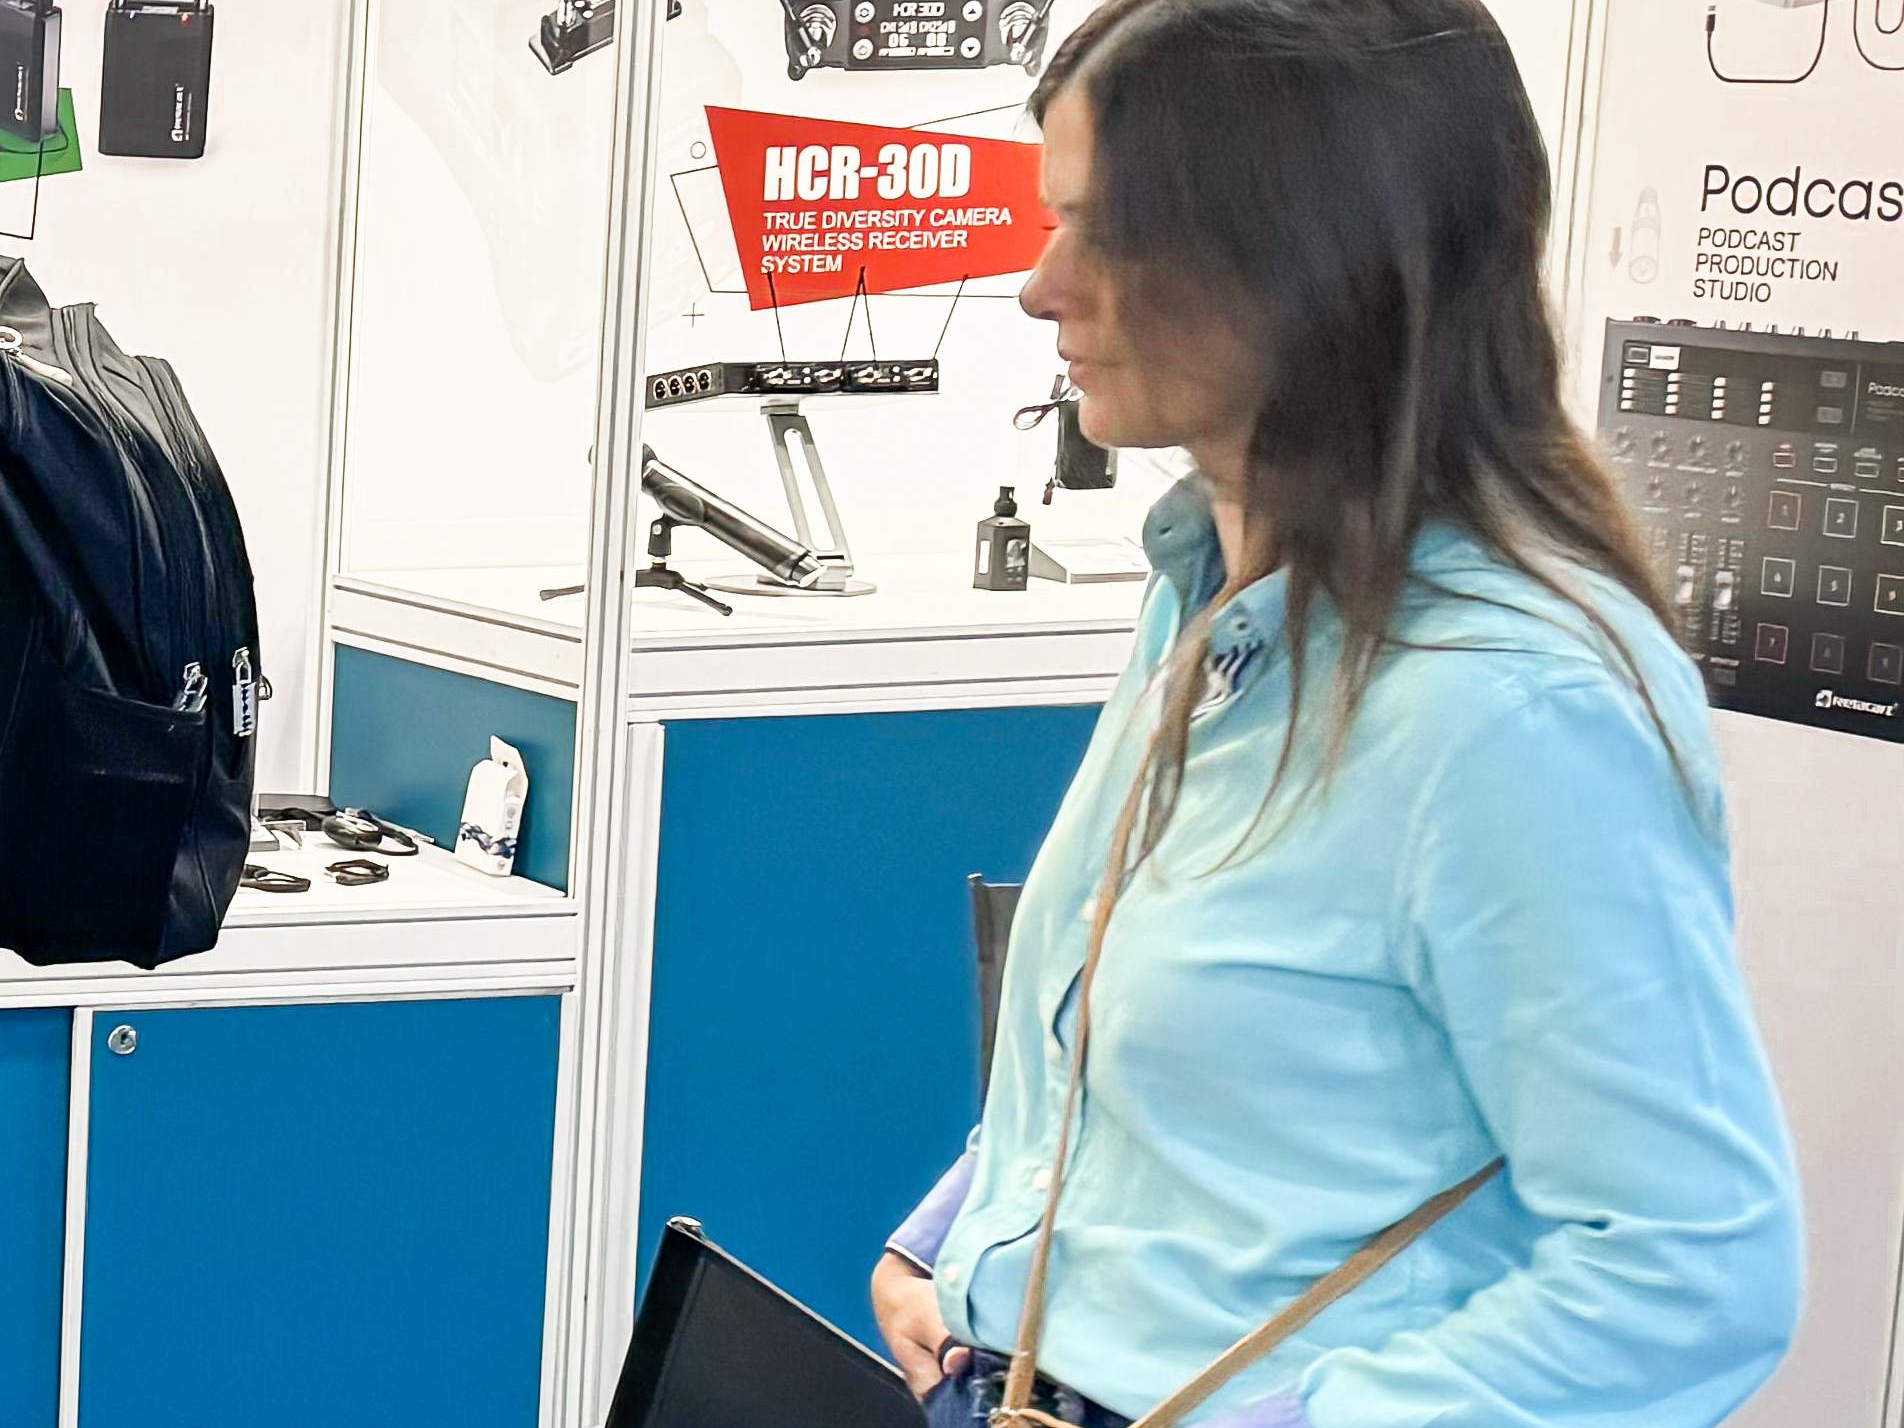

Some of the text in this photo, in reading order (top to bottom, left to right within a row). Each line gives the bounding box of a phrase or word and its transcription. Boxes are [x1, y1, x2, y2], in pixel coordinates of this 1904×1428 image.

[763, 143, 972, 202] HCR-30D
[1700, 164, 1904, 222] Podcas
[763, 207, 1012, 230] TRUE DIVERSITY CAMERA
[761, 229, 968, 252] WIRELESS RECEIVER
[1697, 227, 1802, 252] PODCAST
[761, 254, 842, 274] SYSTEM
[1695, 253, 1839, 282] PRODUCTION
[1693, 278, 1772, 303] STUDIO
[1833, 694, 1895, 717] Relacart
